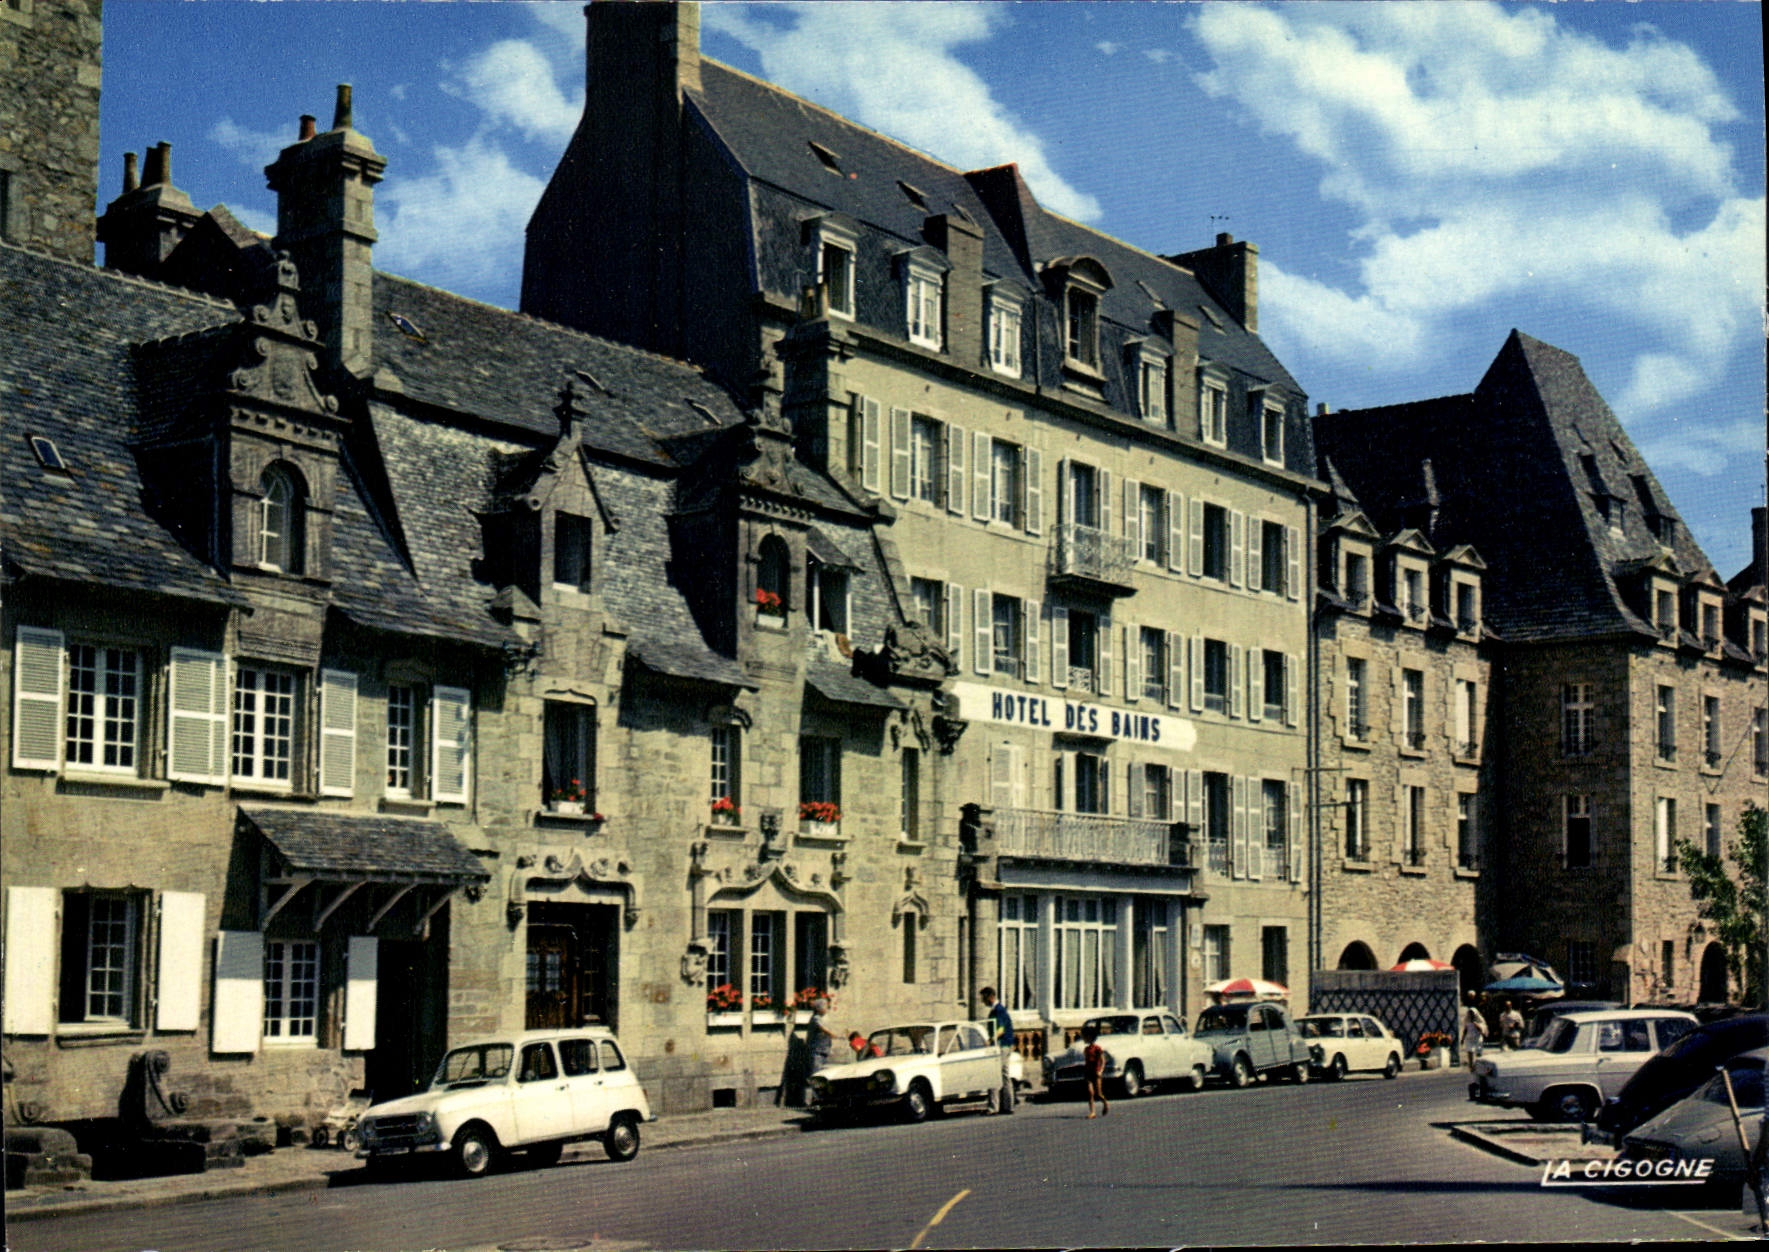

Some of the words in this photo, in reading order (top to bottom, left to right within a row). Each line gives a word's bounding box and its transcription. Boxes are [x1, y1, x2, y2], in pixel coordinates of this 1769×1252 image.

[992, 691, 1051, 727] HOTEL
[1065, 703, 1098, 733] DES
[1111, 711, 1161, 742] BAINS
